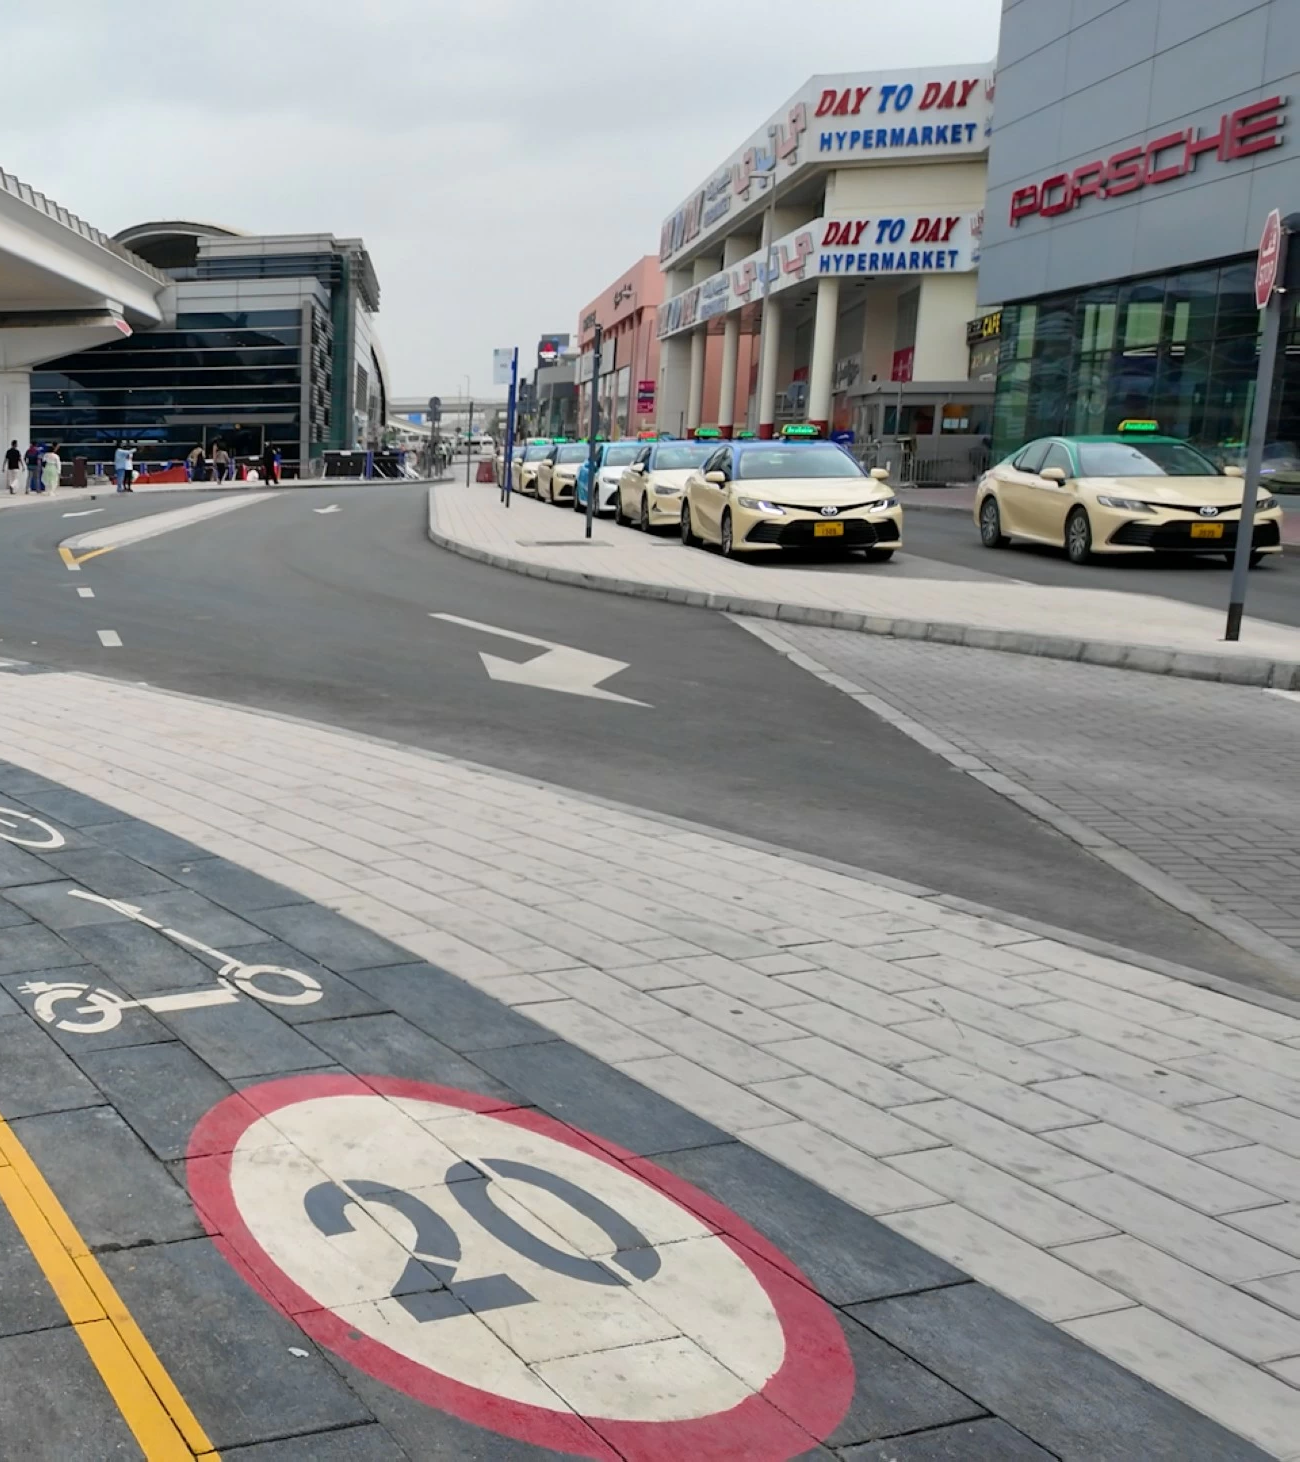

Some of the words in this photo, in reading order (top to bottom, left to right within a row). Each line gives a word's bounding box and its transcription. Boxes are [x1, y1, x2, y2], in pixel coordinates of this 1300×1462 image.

[815, 87, 872, 118] DAY
[878, 83, 914, 114] TO
[918, 79, 979, 111] DAY
[819, 123, 977, 152] HYPERMARKET
[1009, 95, 1287, 228] PORSCHE
[822, 220, 870, 247] DAY
[875, 218, 906, 245] TO
[910, 216, 960, 244] DAY
[819, 249, 959, 273] HYPERMARKET
[303, 1157, 662, 1324] 20
